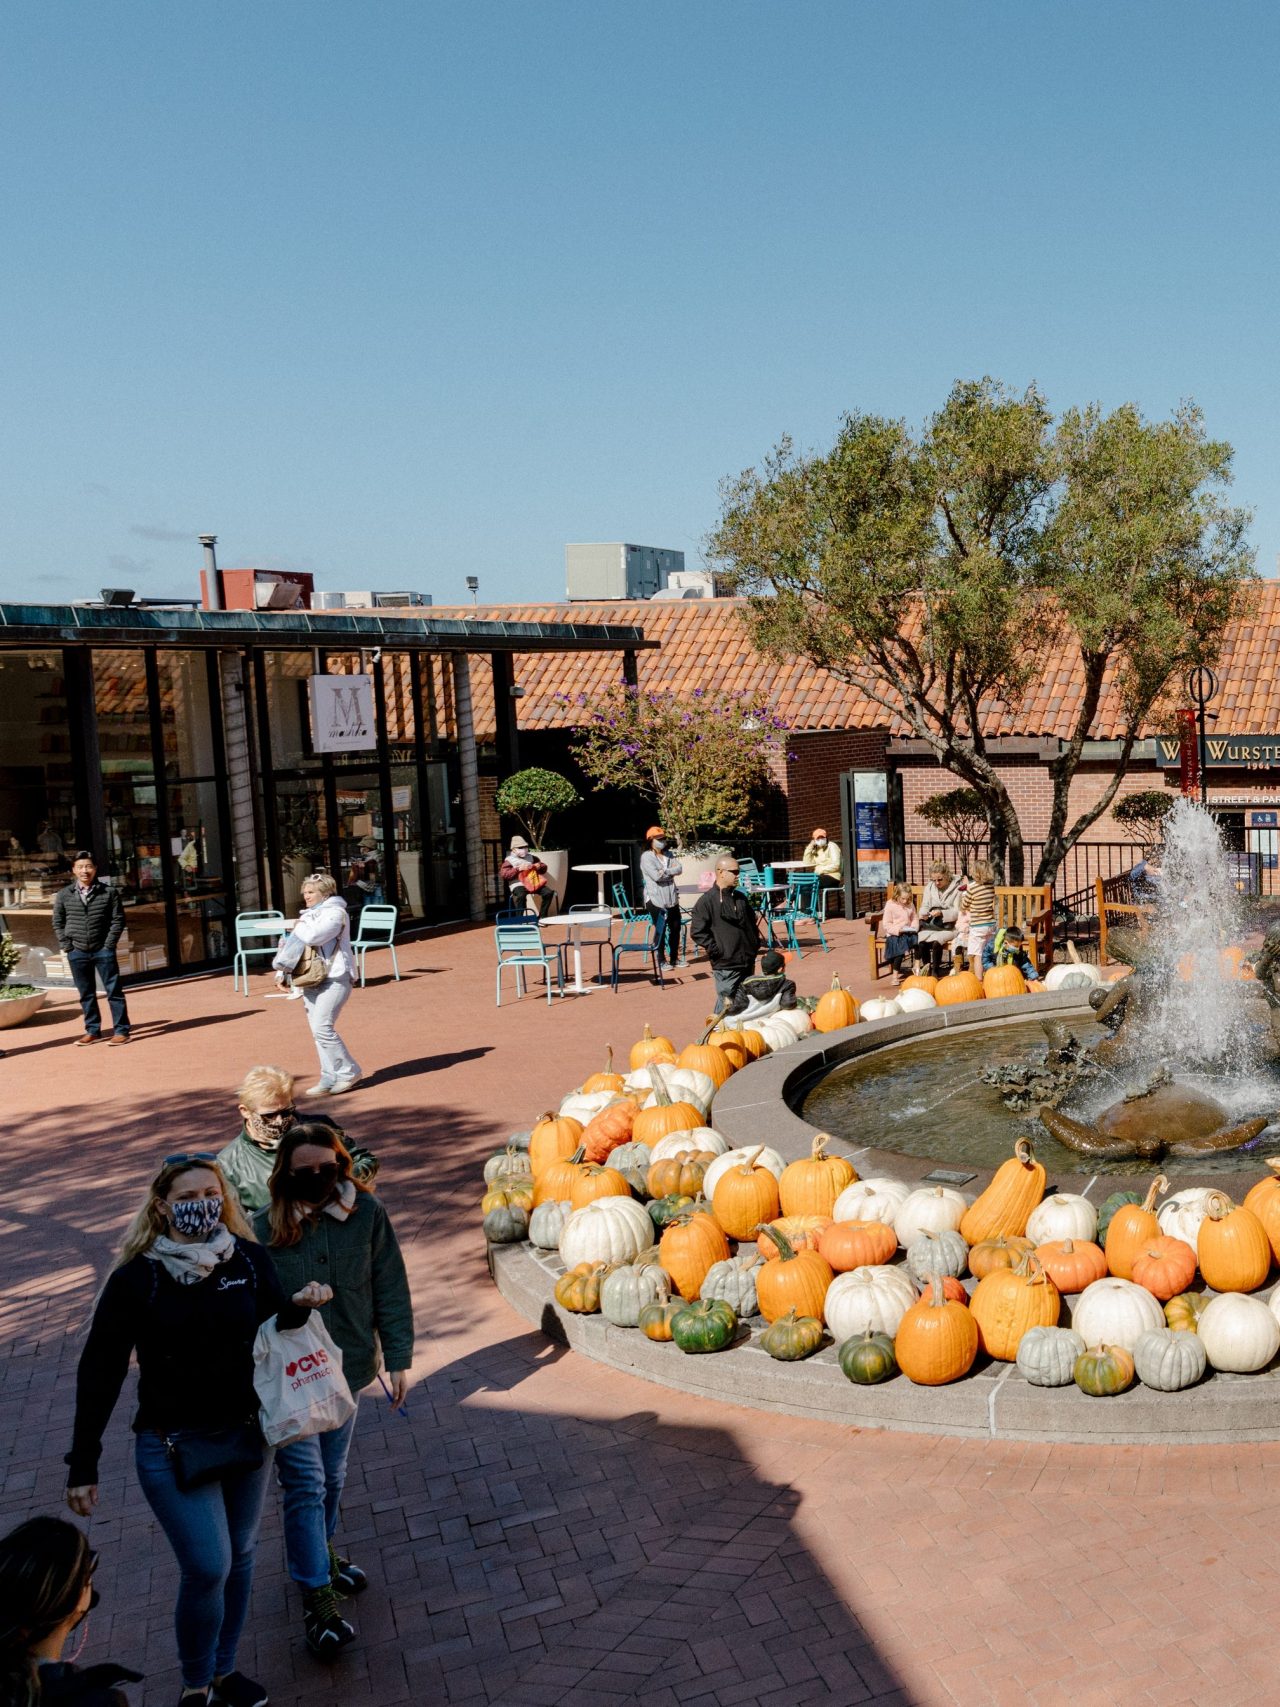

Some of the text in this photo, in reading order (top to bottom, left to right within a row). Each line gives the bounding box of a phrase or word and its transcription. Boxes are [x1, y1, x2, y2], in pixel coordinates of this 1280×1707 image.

[1247, 762, 1271, 770] 1964
[1211, 796, 1250, 804] STREET
[1252, 795, 1260, 804] &
[299, 1349, 329, 1372] CVS
